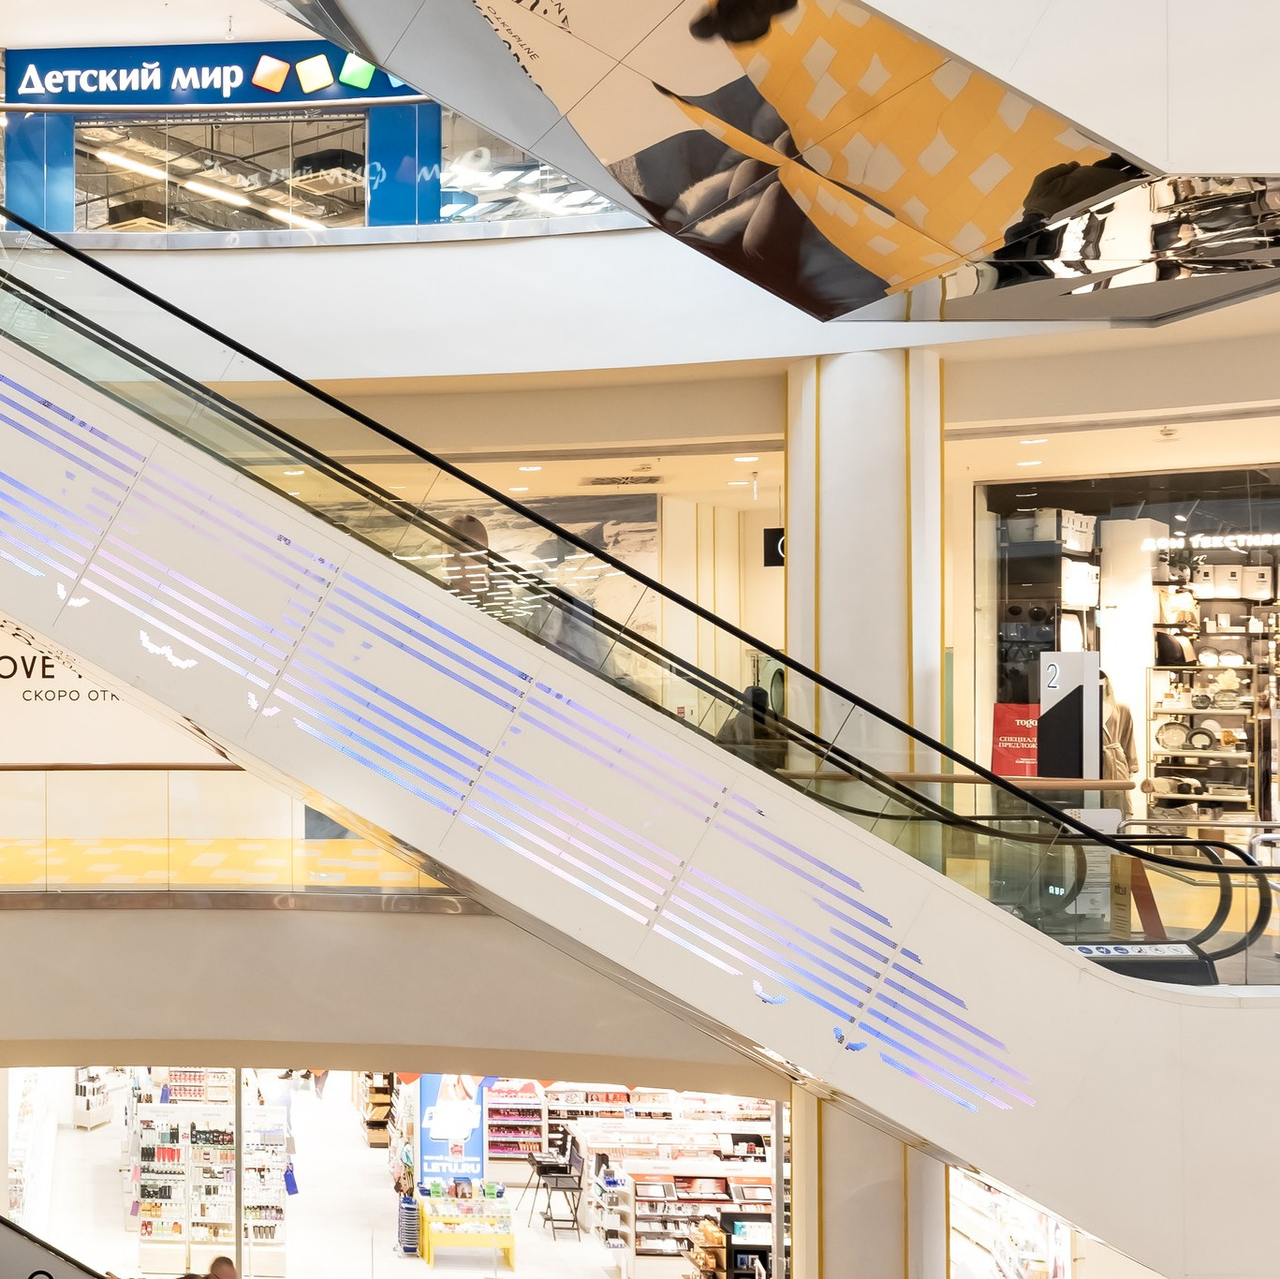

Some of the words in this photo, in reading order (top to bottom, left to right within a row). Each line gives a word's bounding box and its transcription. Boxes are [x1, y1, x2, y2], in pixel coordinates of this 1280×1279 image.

[17, 61, 161, 95] Детский
[171, 65, 244, 98] мир
[1046, 662, 1059, 690] 2
[22, 689, 81, 702] СКОРО
